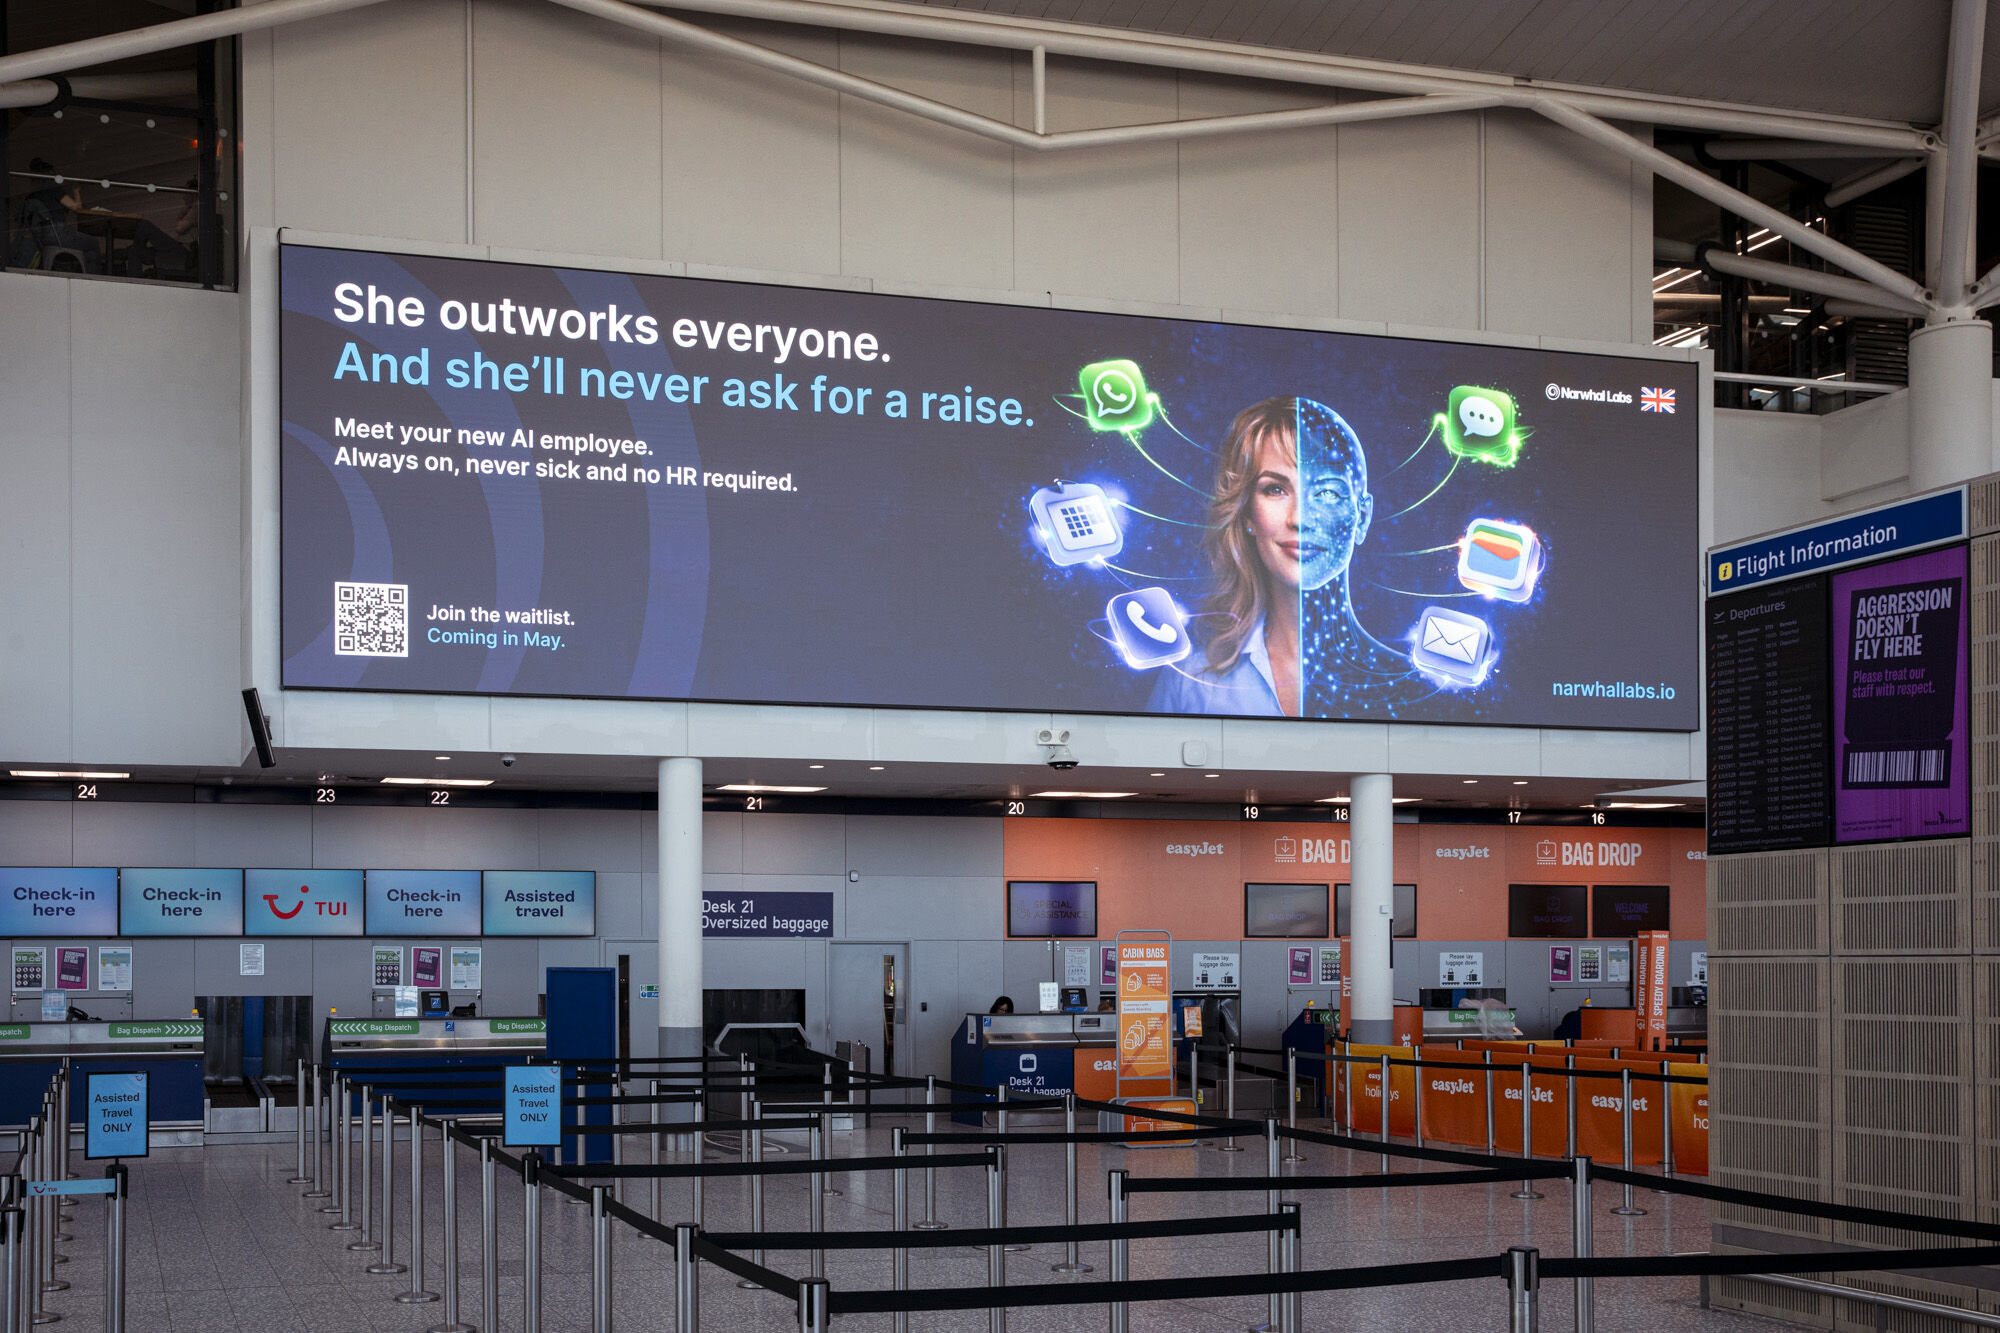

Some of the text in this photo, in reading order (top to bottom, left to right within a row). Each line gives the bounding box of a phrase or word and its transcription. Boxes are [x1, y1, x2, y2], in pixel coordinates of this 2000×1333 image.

[333, 282, 891, 364] She outworks everyone.
[333, 342, 1035, 427] And she’ll never ask for a raise.
[1561, 386, 1632, 404] Narwhal Labs
[334, 417, 654, 458] Meet your new AI employee.
[334, 447, 798, 493] Always on, never sick and no HR required.
[1736, 525, 1897, 577] Flight Information
[1857, 586, 1953, 619] AGGRESSION
[427, 604, 575, 626] Join the waitlist.
[1729, 599, 1786, 622] Departures
[1856, 613, 1920, 640] DOESN’T
[427, 627, 566, 650] Coming in May.
[1855, 634, 1922, 661] FLY HERE
[1853, 666, 1925, 684] Please treat our
[1552, 680, 1676, 700] narwhallabs.io
[1852, 679, 1936, 698] staff with respect.
[78, 784, 98, 799] 24
[317, 788, 335, 802] 23
[431, 791, 450, 804] 22
[746, 797, 763, 810] 21
[1008, 801, 1025, 815] 20
[1244, 806, 1258, 819] 19
[1334, 808, 1348, 821] 18
[1508, 812, 1521, 824] 17
[1592, 813, 1605, 825] 16
[1166, 842, 1224, 857] easyJet
[1302, 839, 1336, 864] BAG
[1436, 845, 1490, 861] easyJet
[1562, 842, 1642, 867] BAG DROP
[13, 887, 95, 902] Check-in
[142, 887, 222, 902] Check-in
[386, 888, 461, 903] Check-in
[504, 889, 575, 903] Assisted
[33, 903, 76, 918] here
[161, 903, 203, 918] here
[315, 902, 347, 916] TUI
[404, 904, 443, 918] here
[515, 904, 564, 918] travel
[702, 900, 754, 913] Desk 21
[1034, 899, 1072, 909] SPECIAL
[1034, 910, 1088, 919] ASSISTANCE
[701, 916, 829, 932] Oversized baggage
[1122, 947, 1165, 959] CABIN BAGS
[1203, 953, 1230, 962] Please lay
[1465, 953, 1473, 961] lay
[1199, 961, 1219, 969] luggage
[1639, 946, 1648, 985] BOARDING
[1653, 945, 1666, 1016] SPEEDY BOARDING
[1638, 986, 1646, 1016] SPEEDY
[0, 1028, 22, 1036] spatch
[117, 1026, 161, 1035] Bag Dispatch
[370, 1023, 412, 1032] Bag Dispatch
[497, 1021, 538, 1031] Bag Dispatch
[512, 1083, 555, 1094] Assisted
[1009, 1076, 1045, 1086] Desk 21
[1432, 1079, 1474, 1095] easyJet
[94, 1093, 139, 1103] Assisted
[1365, 1084, 1399, 1102] holiys
[1505, 1087, 1553, 1103] easJet
[519, 1098, 548, 1108] Travel
[1592, 1095, 1648, 1112] easyet
[102, 1108, 133, 1117] Travel
[520, 1112, 548, 1123] ONLY
[102, 1123, 132, 1133] ONLY
